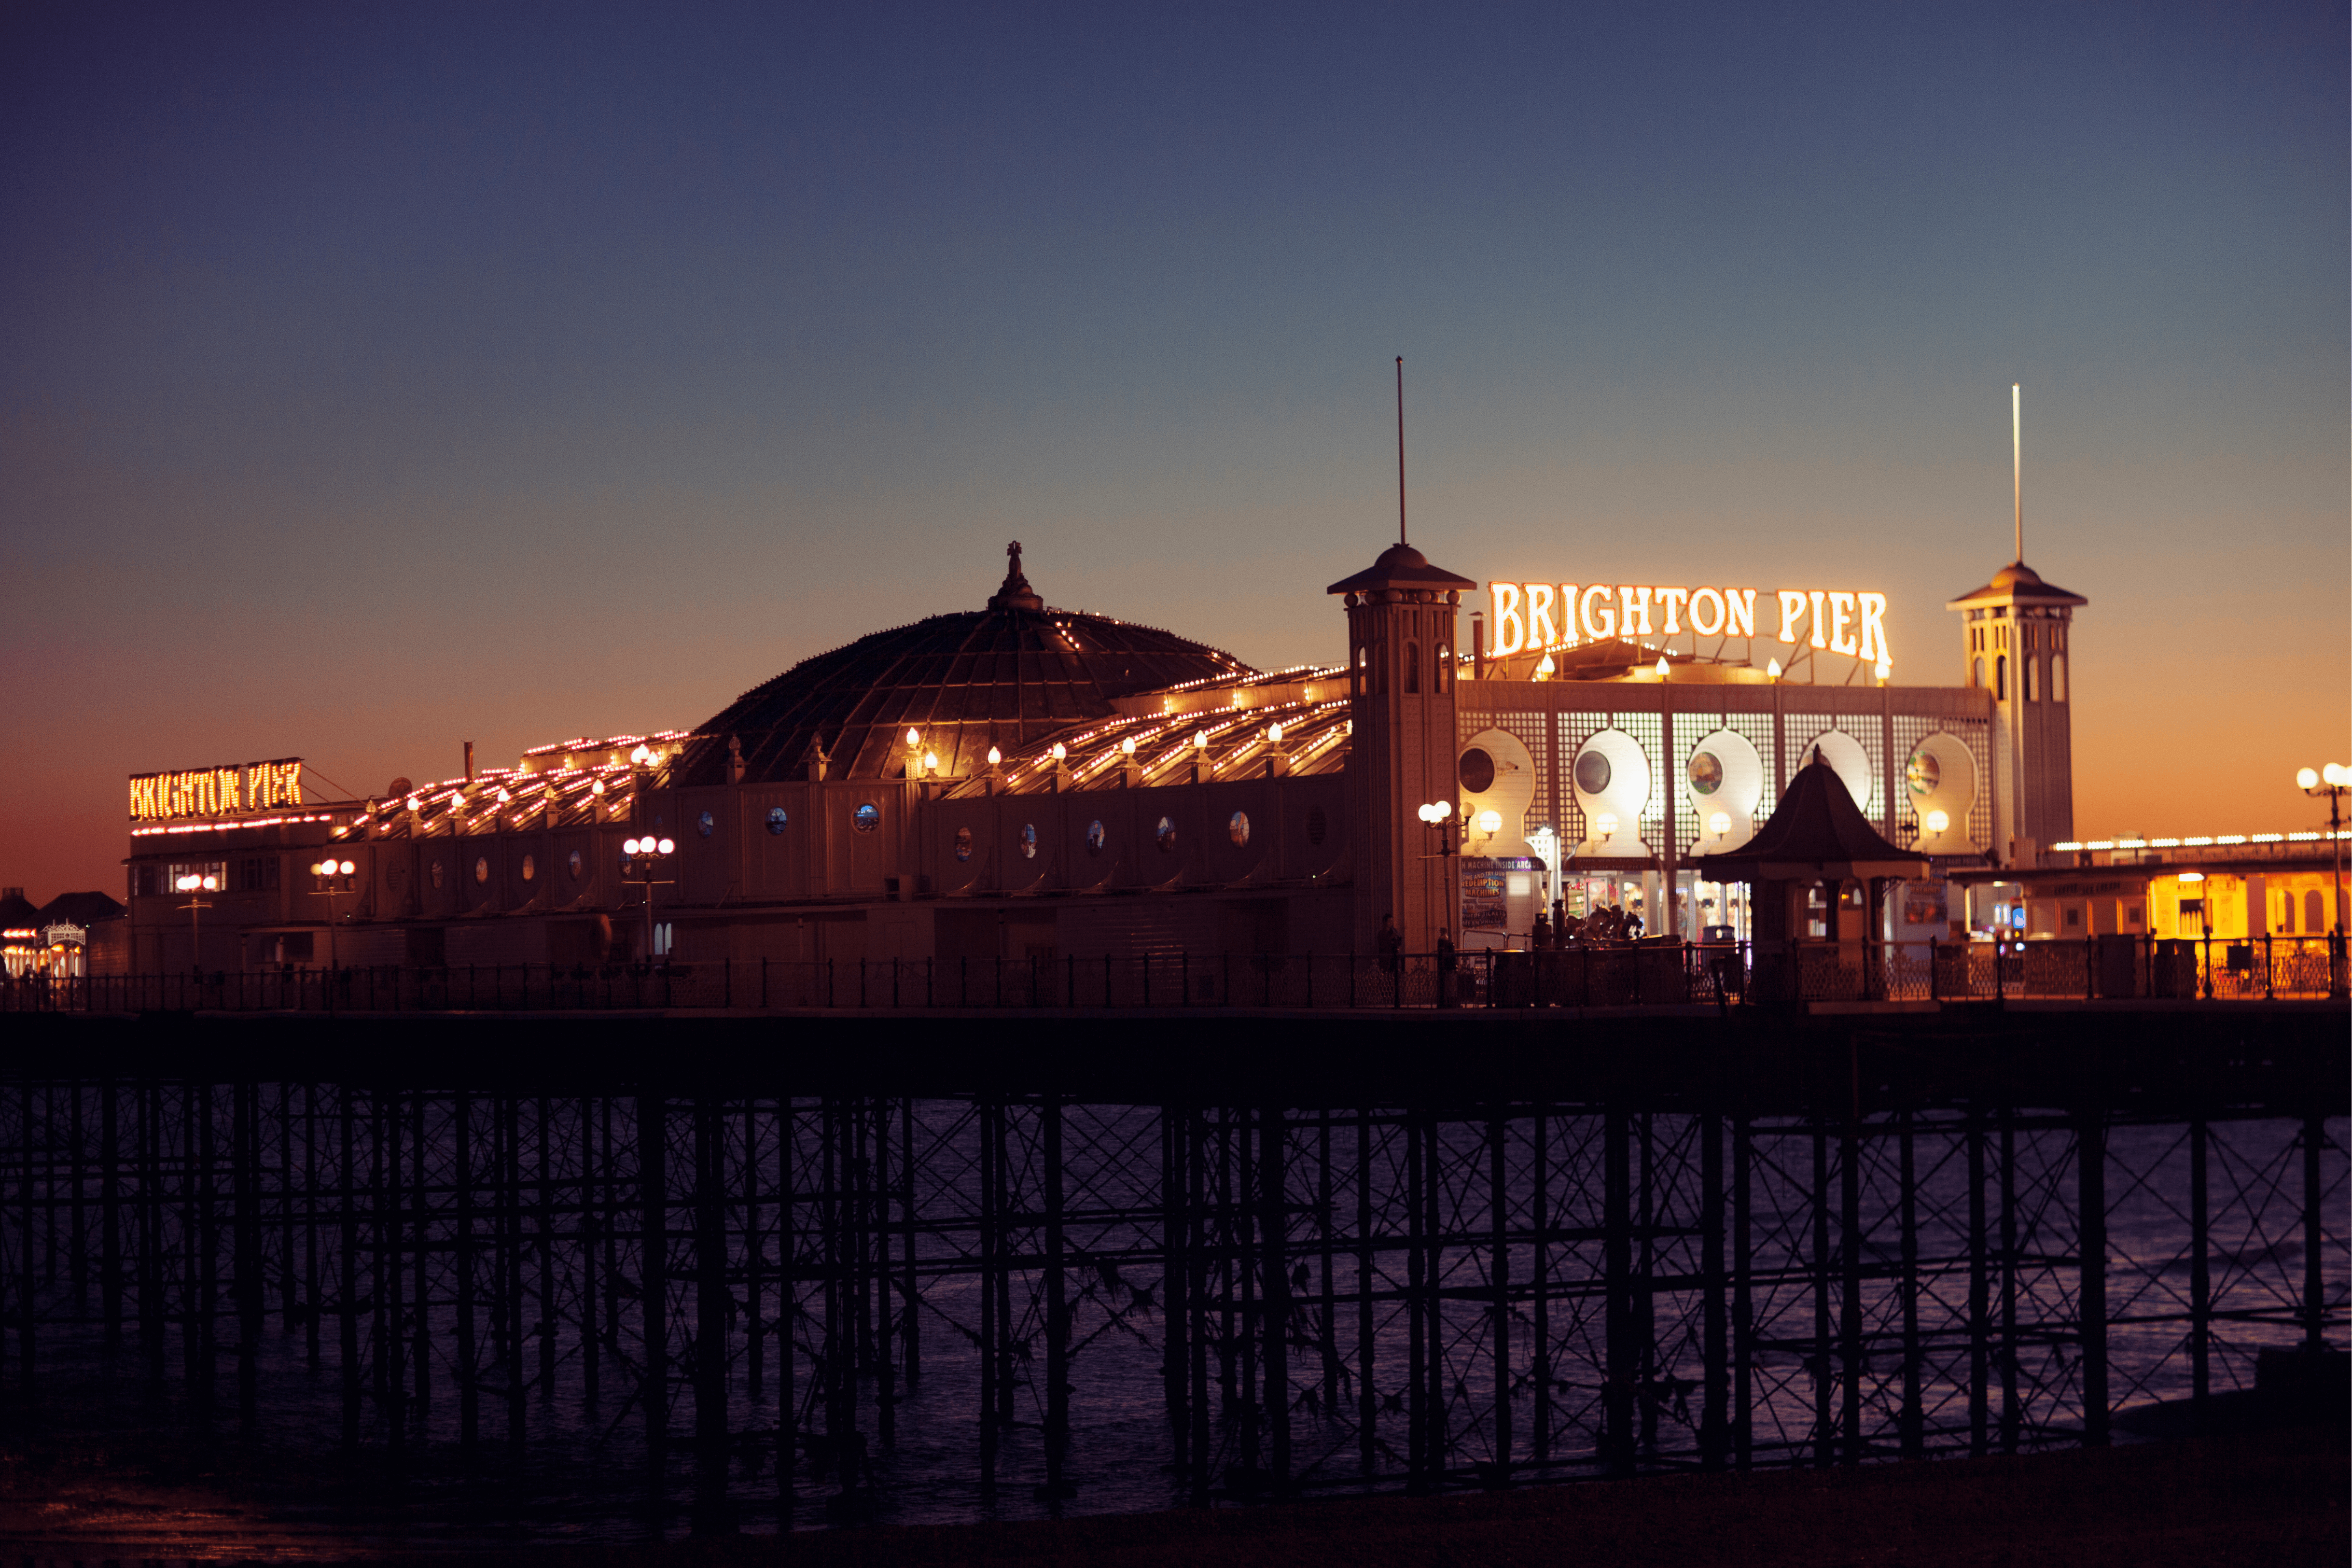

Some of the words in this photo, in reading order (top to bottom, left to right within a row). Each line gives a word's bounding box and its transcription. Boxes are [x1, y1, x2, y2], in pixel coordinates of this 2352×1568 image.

[1490, 581, 1757, 660] BRIGHTON
[1777, 590, 1893, 666] PIER
[129, 767, 241, 818] BRIGHTON
[248, 760, 302, 809] PIER
[1468, 861, 1493, 869] MACHINE
[1496, 861, 1514, 869] INSIDE
[1517, 860, 1539, 869] ARCADE
[1462, 879, 1504, 887] REDEMPTION
